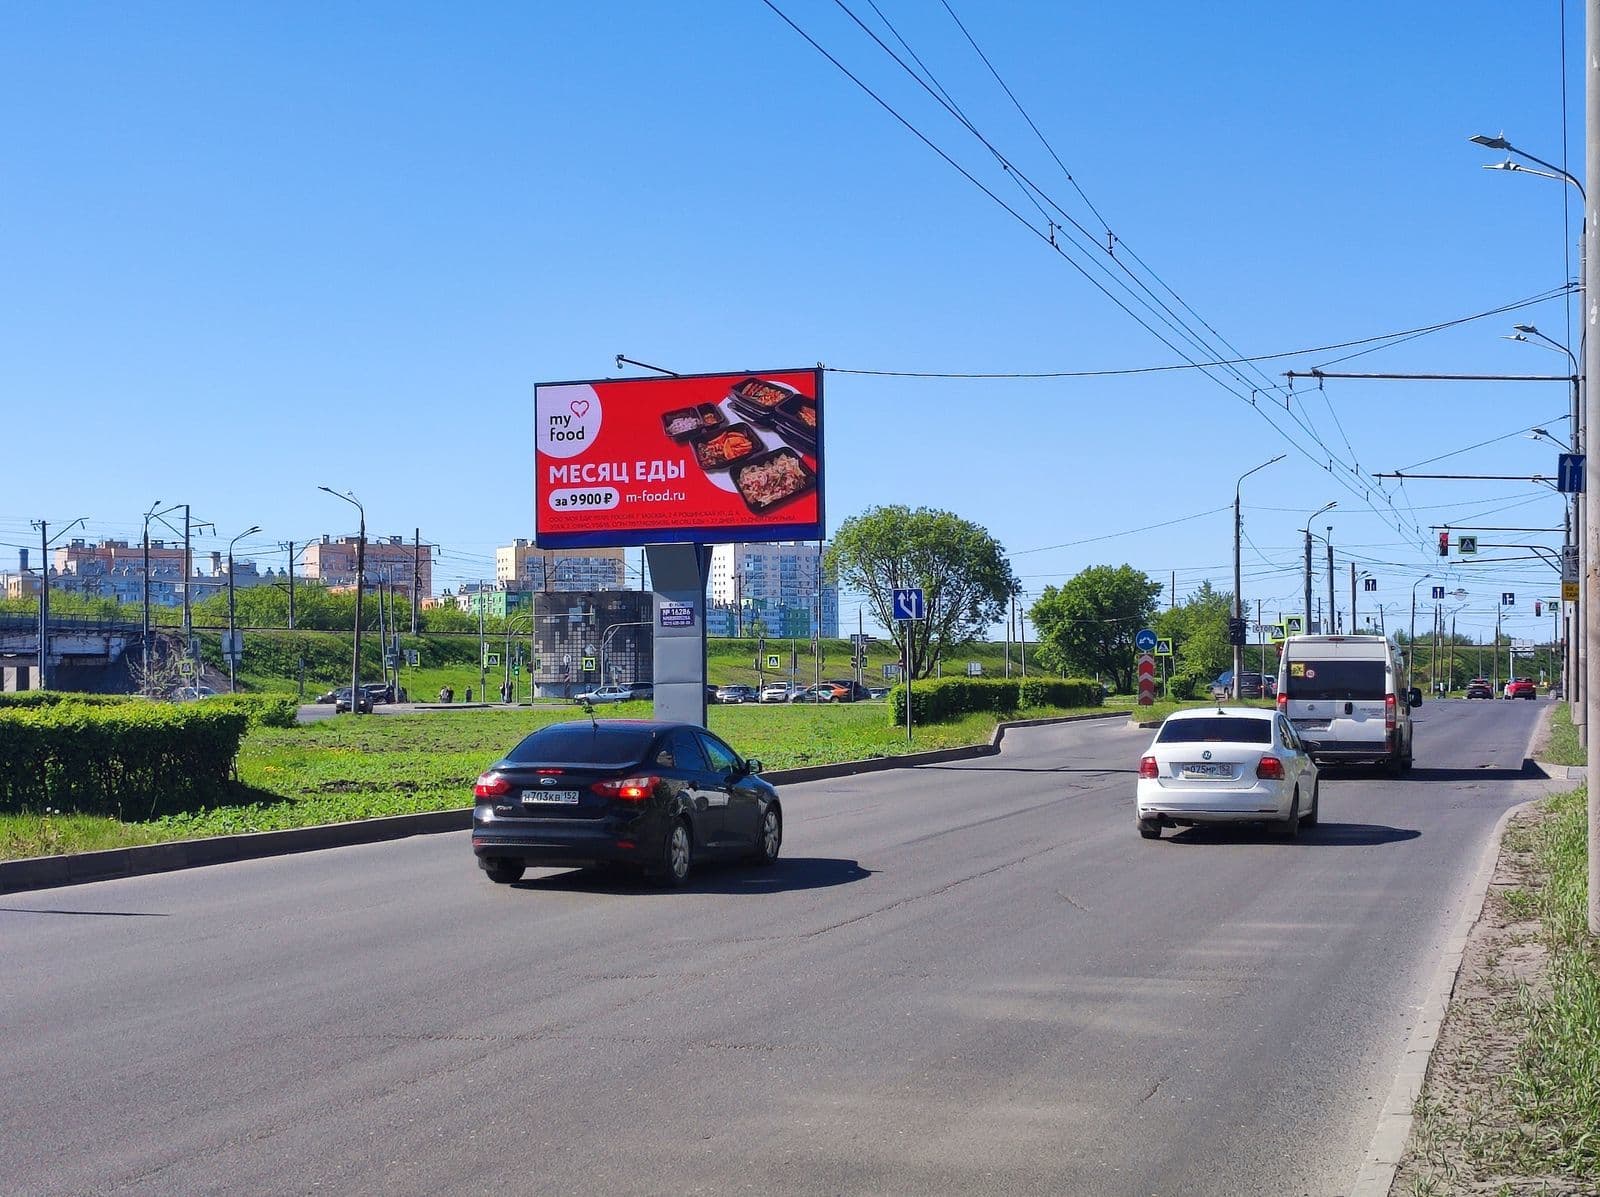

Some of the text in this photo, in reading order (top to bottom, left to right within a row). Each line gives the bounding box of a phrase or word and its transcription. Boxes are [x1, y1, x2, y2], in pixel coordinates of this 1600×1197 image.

[550, 415, 571, 428] my
[550, 426, 585, 441] food
[549, 460, 685, 484] МЕСЯЦ ЕДЫ
[555, 498, 568, 507] за
[626, 490, 686, 503] m-food.ru
[564, 791, 577, 800] 152
